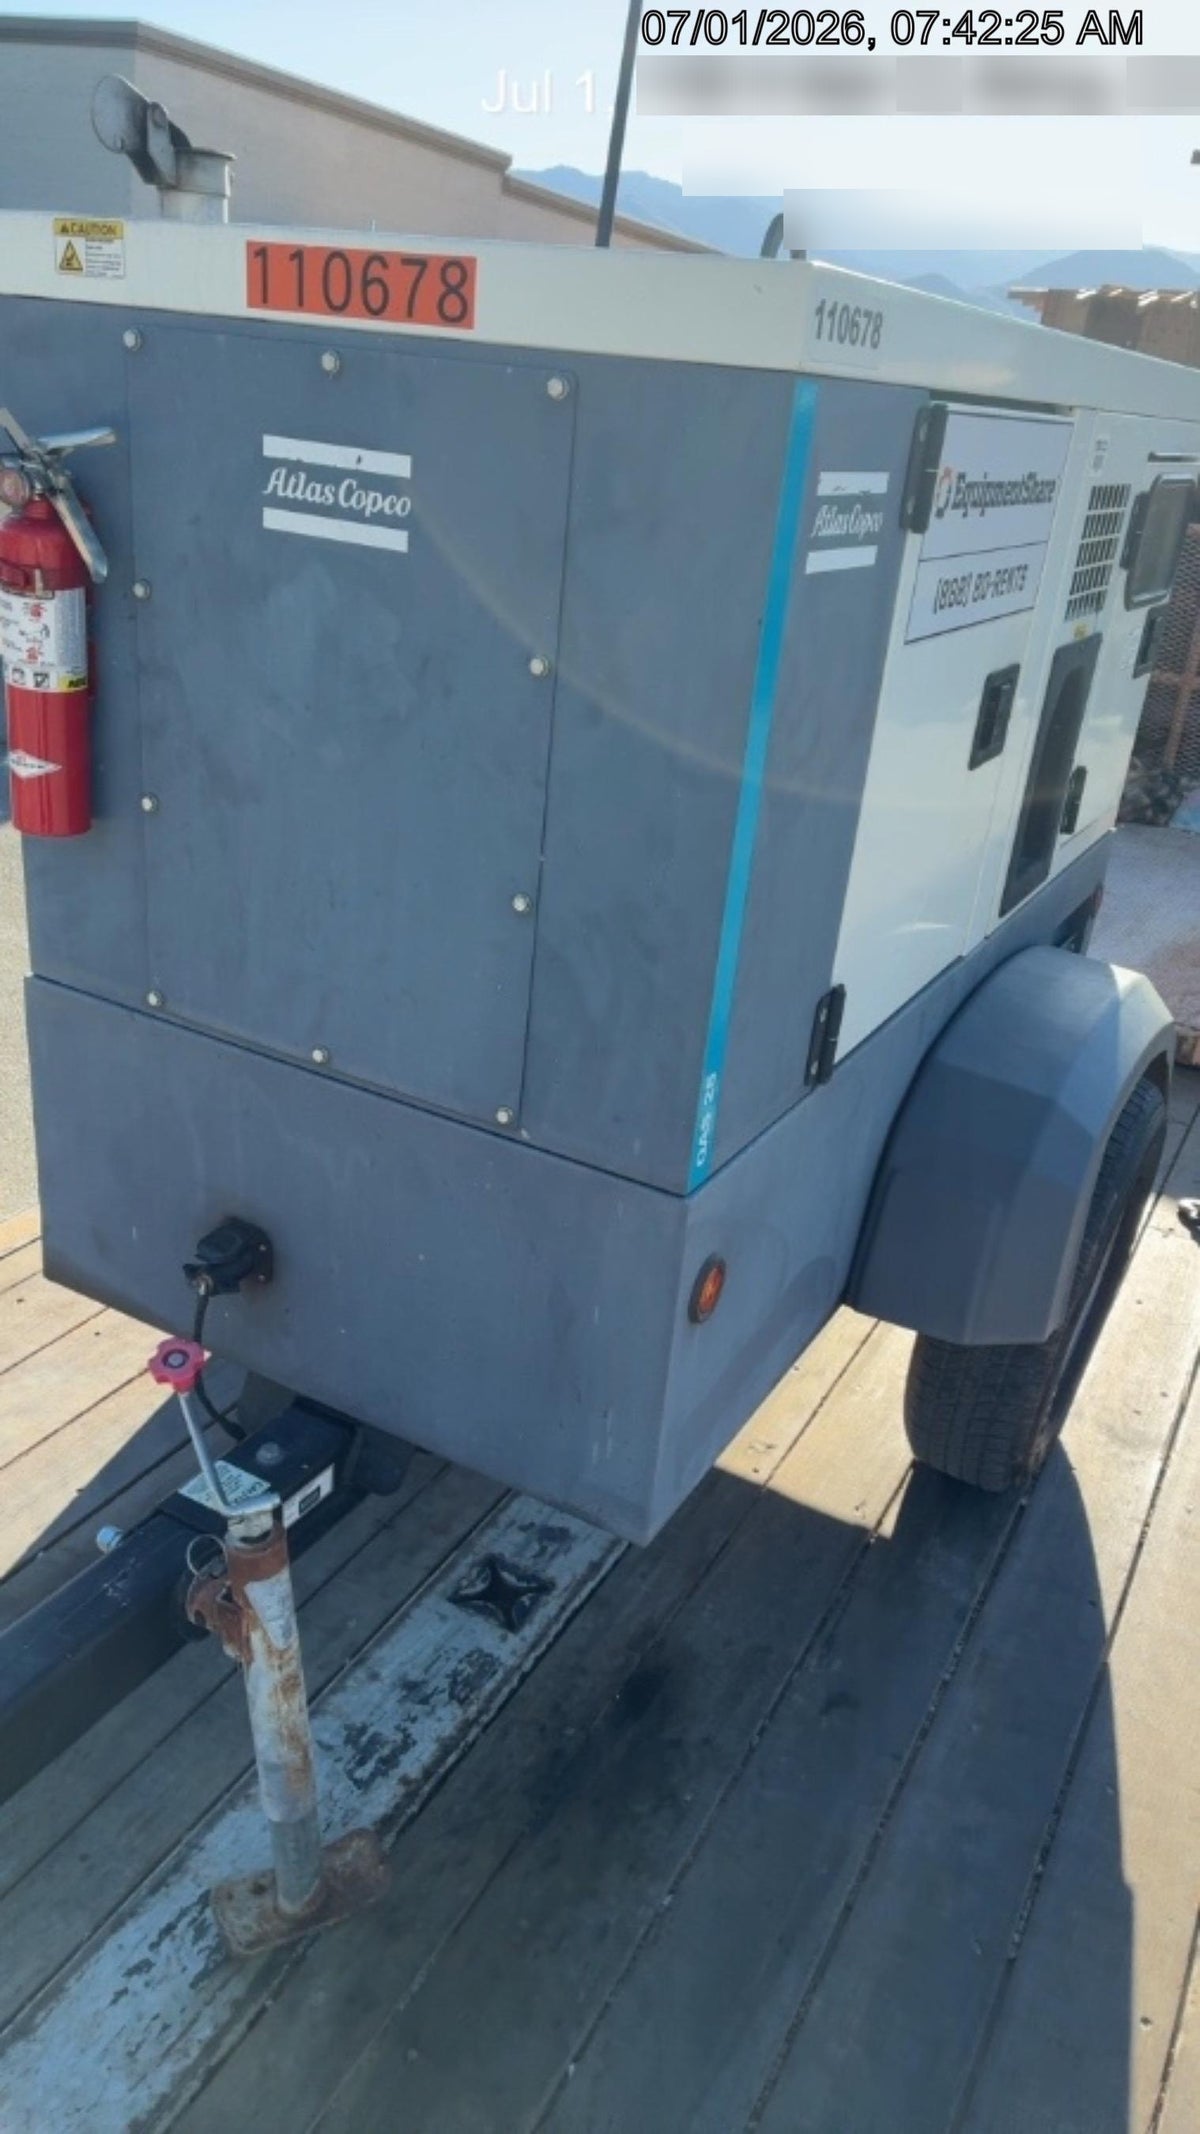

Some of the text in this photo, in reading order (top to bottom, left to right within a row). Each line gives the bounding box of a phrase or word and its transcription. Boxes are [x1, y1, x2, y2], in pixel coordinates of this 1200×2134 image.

[253, 246, 468, 323] 110678
[815, 298, 883, 350] 110678
[261, 466, 411, 519] Atlas Copco
[951, 471, 1057, 518] EquipmentShare
[810, 503, 884, 541] Atlas Copco
